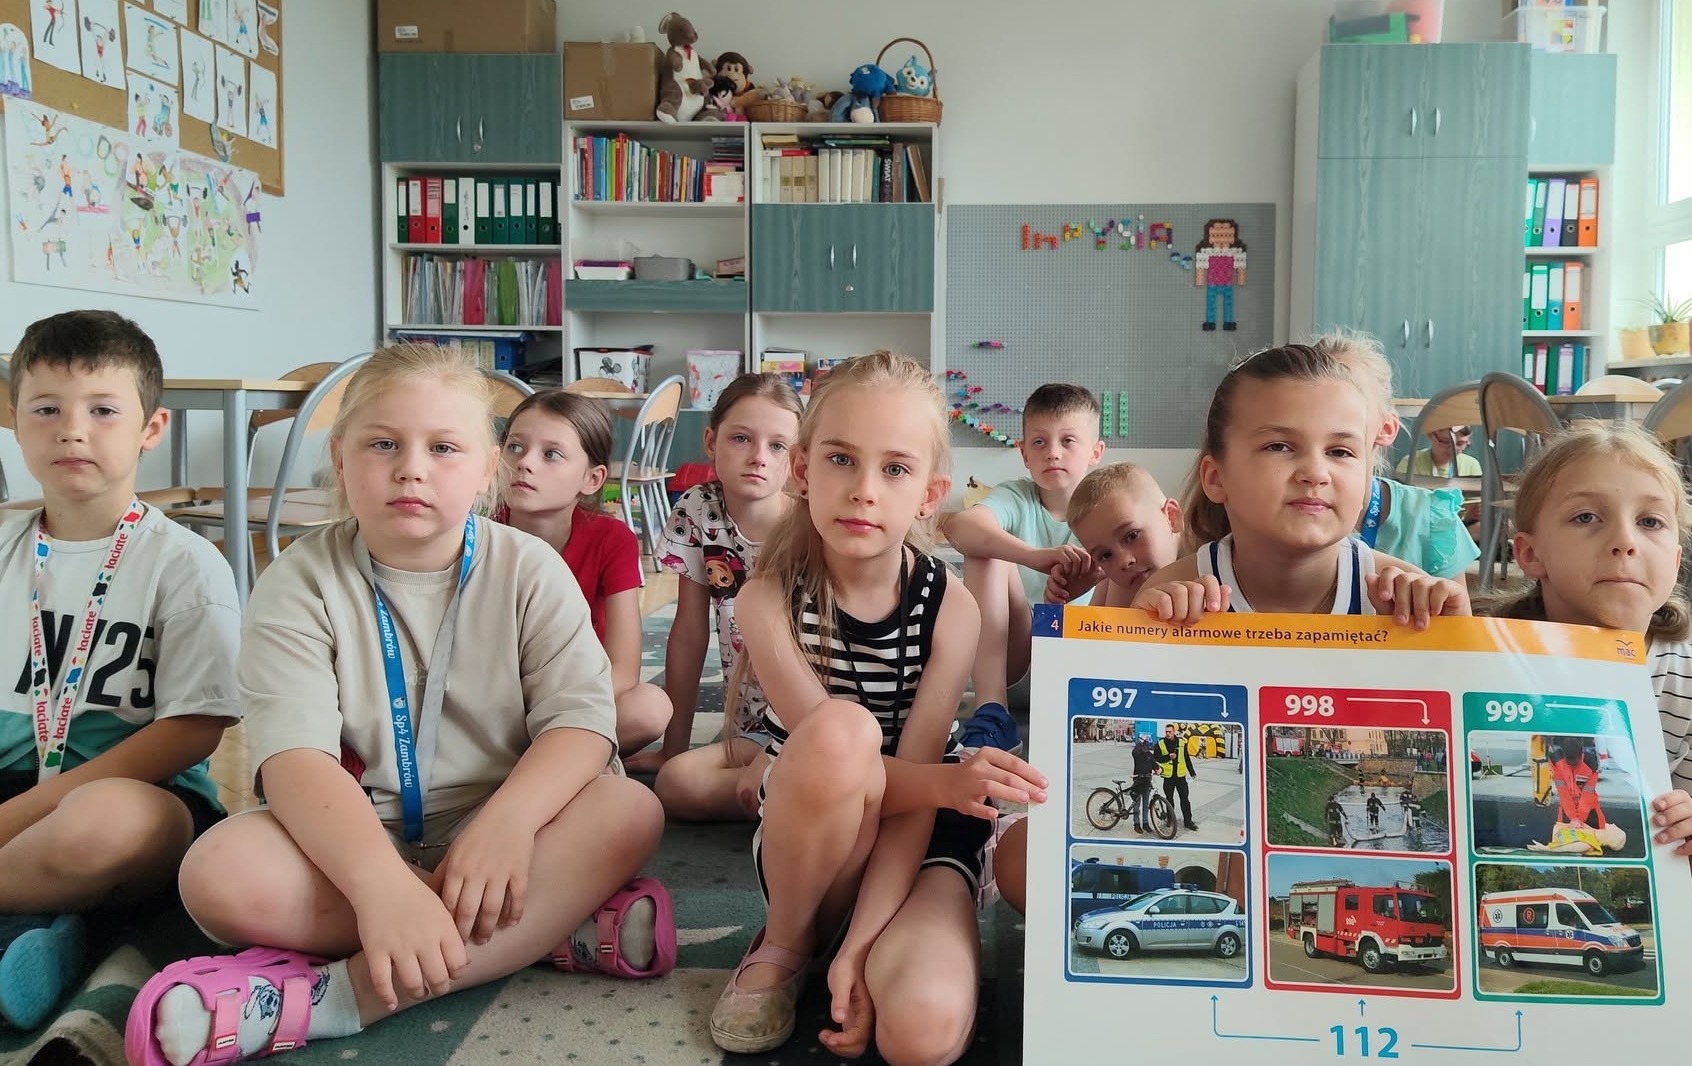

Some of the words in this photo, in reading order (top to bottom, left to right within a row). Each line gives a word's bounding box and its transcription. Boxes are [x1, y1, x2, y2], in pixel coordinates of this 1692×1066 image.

[380, 609, 396, 659] Zambrów
[1050, 619, 1060, 631] 4
[1077, 620, 1113, 634] Jakie
[1116, 625, 1168, 639] numery
[1172, 626, 1242, 639] alarmowe
[1246, 628, 1292, 640] trzeba
[1296, 629, 1389, 644] zapamiętać?
[1092, 686, 1138, 709] 997
[1285, 694, 1335, 717] 998
[1485, 700, 1534, 723] 999
[393, 714, 409, 735] Sp4
[399, 737, 415, 788] Zambrów
[1330, 1025, 1399, 1058] 112
